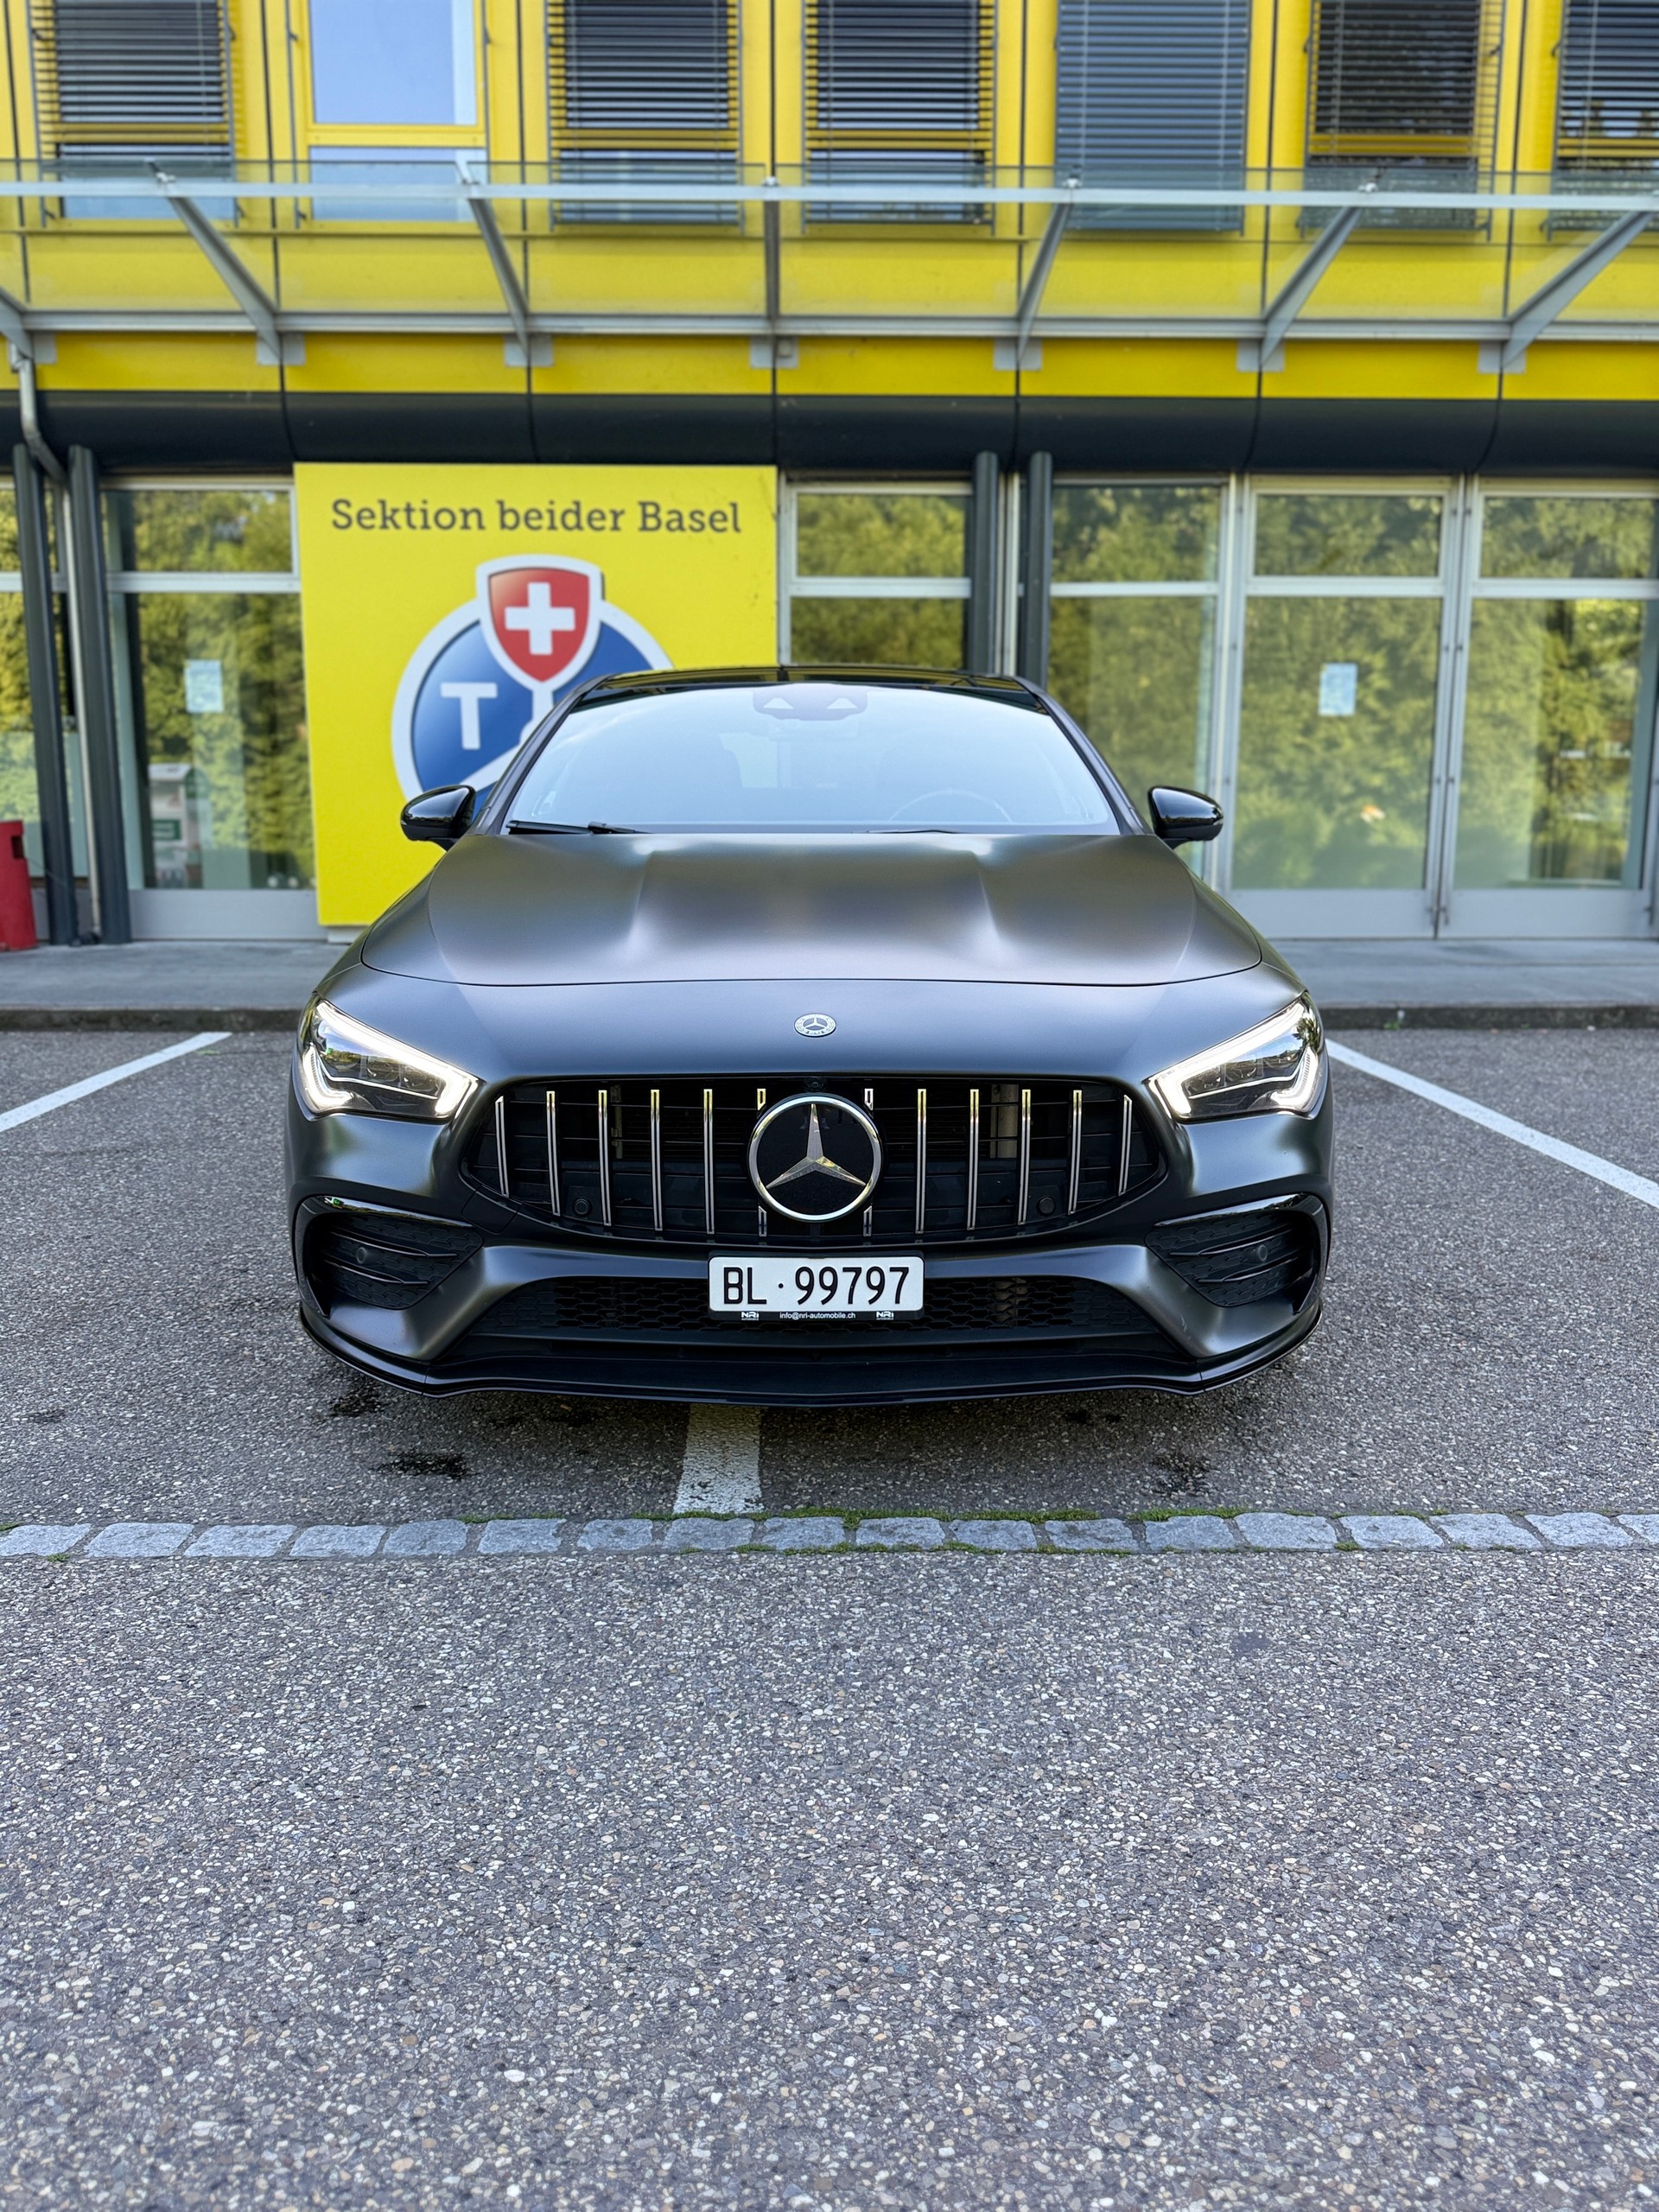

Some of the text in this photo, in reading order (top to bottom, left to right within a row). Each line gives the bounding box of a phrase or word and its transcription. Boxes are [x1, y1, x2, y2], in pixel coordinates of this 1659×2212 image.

[332, 499, 741, 533] Sektion beider Basel
[723, 1267, 767, 1305] BL
[795, 1266, 910, 1306] 99797
[779, 1312, 856, 1320] info@nri-automobile.ch
